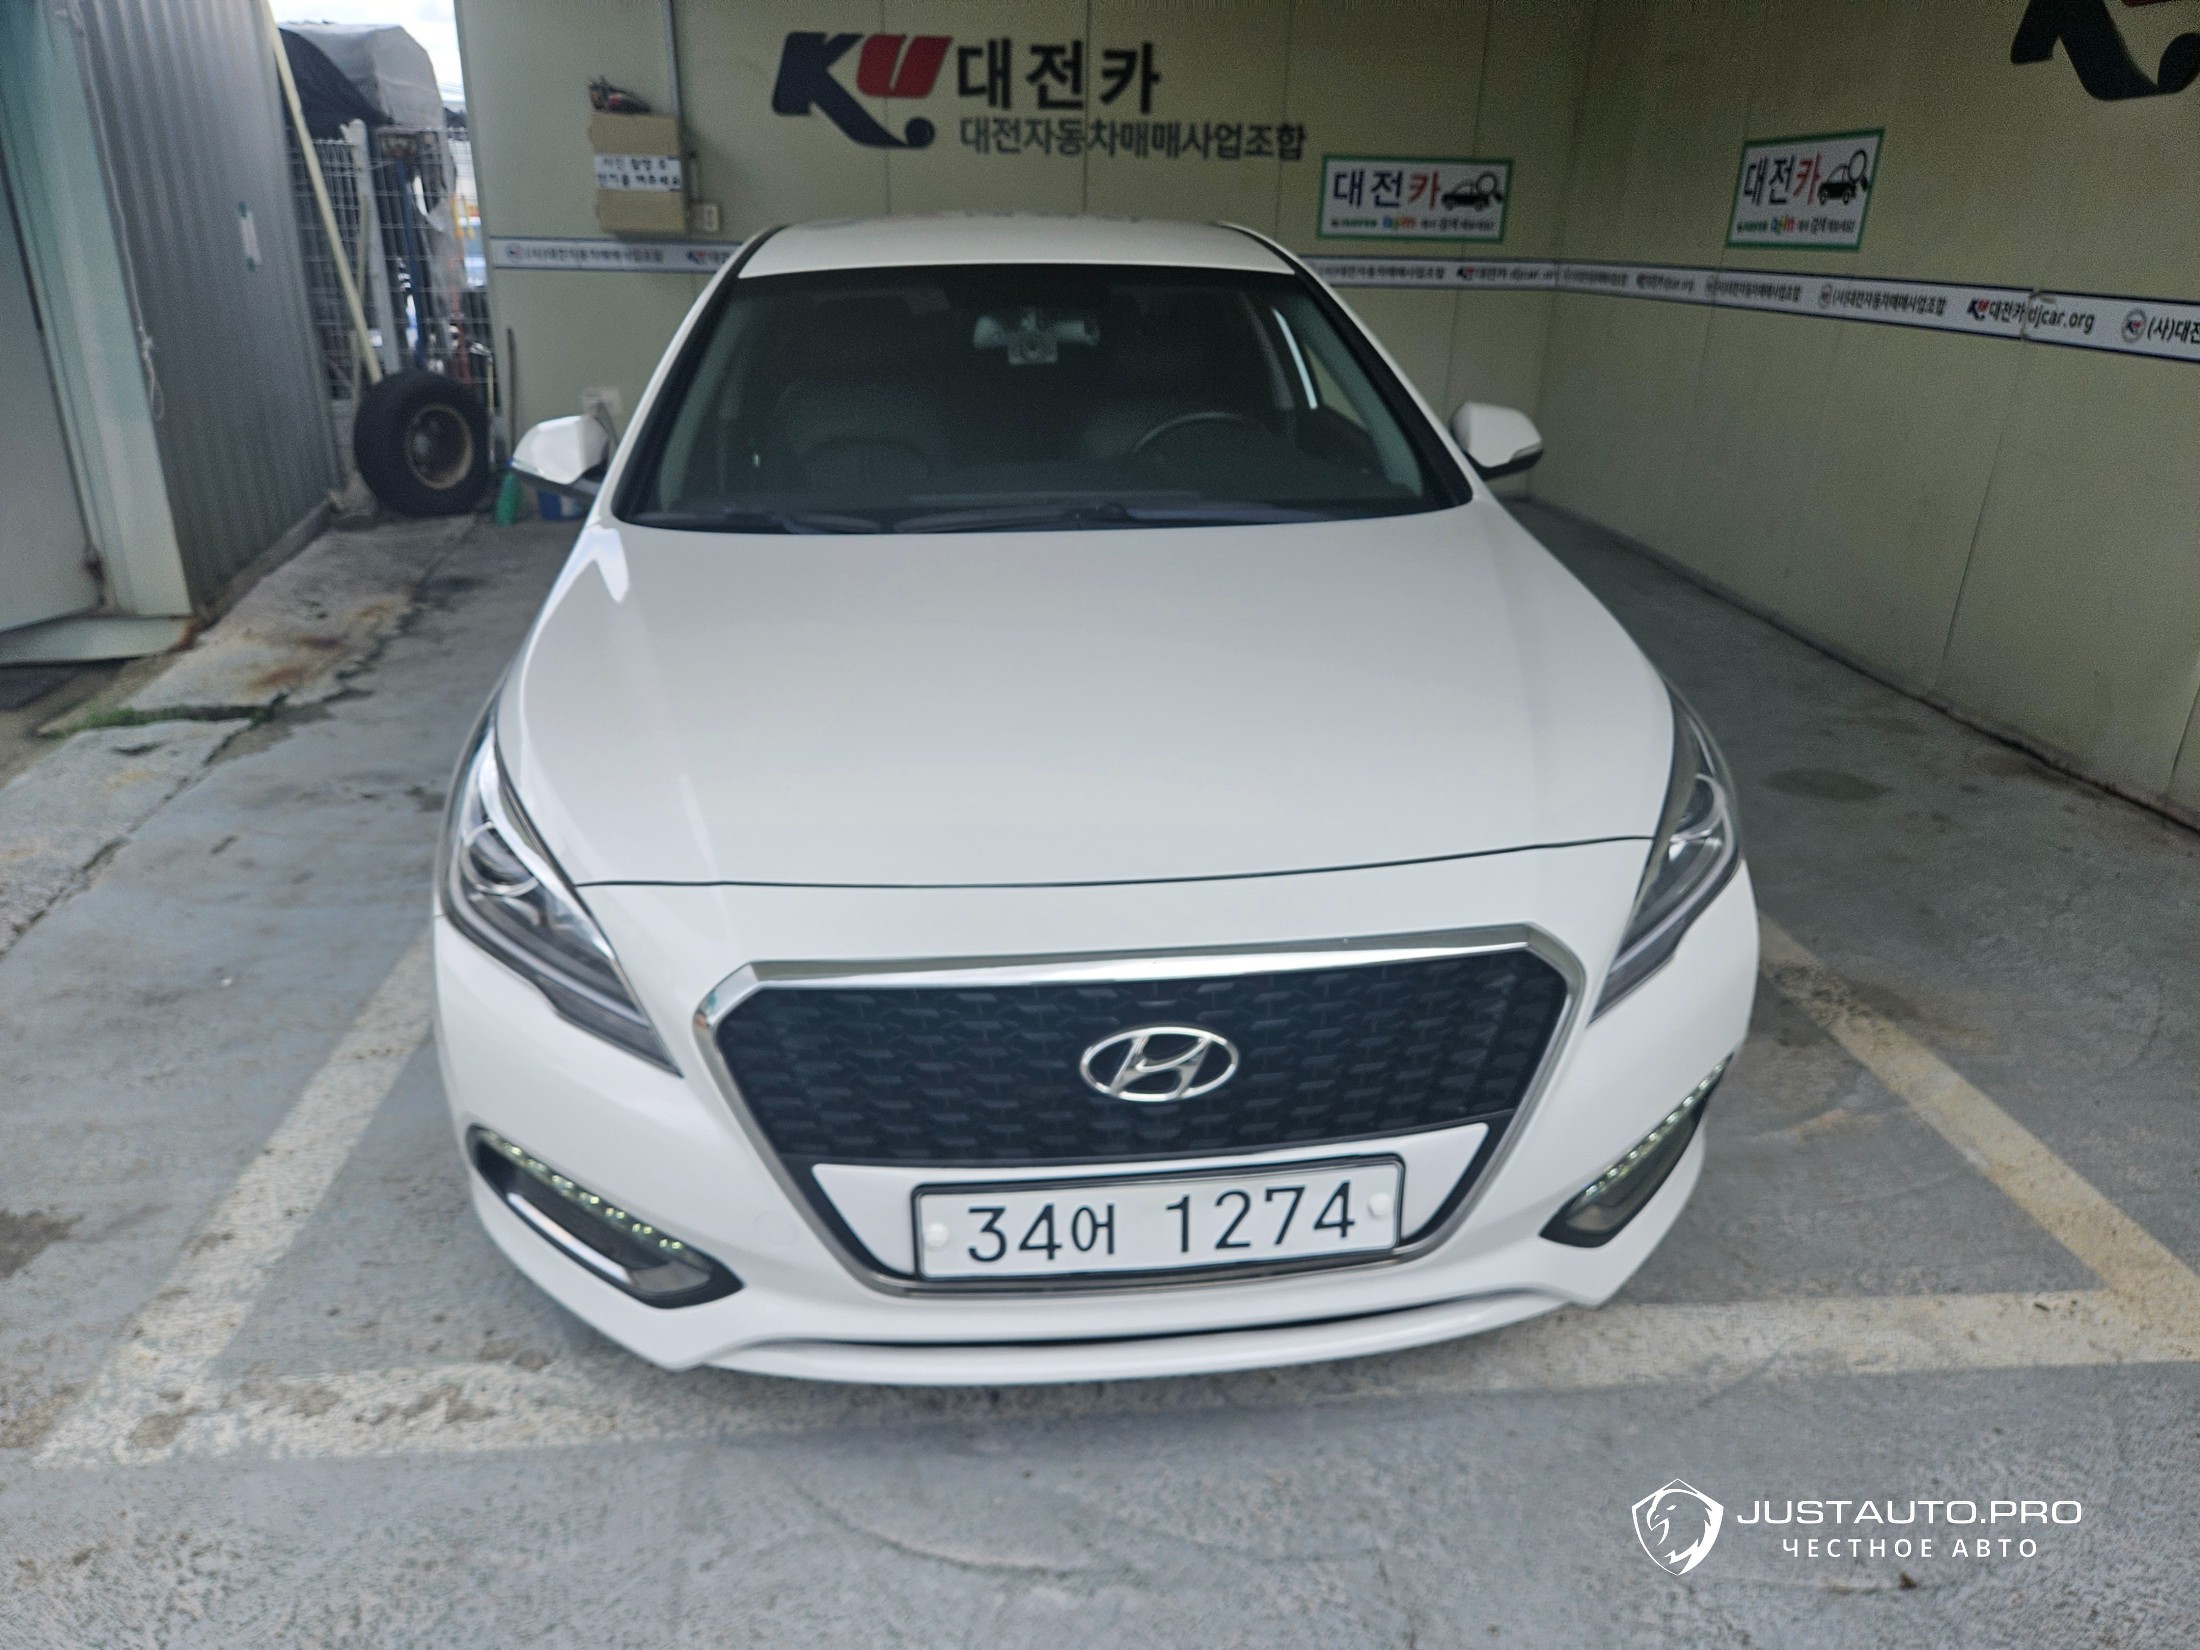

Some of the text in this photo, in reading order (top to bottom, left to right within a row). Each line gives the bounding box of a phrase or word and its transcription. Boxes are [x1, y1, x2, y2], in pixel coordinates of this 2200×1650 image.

[957, 37, 1161, 115] 대전카
[960, 116, 1308, 161] 대전자동차매매사업조합
[1332, 169, 1441, 210] 대전카
[1742, 151, 1822, 206] 대전카
[2027, 303, 2096, 335] djcar.org
[966, 1180, 1356, 1263] 34어 1274
